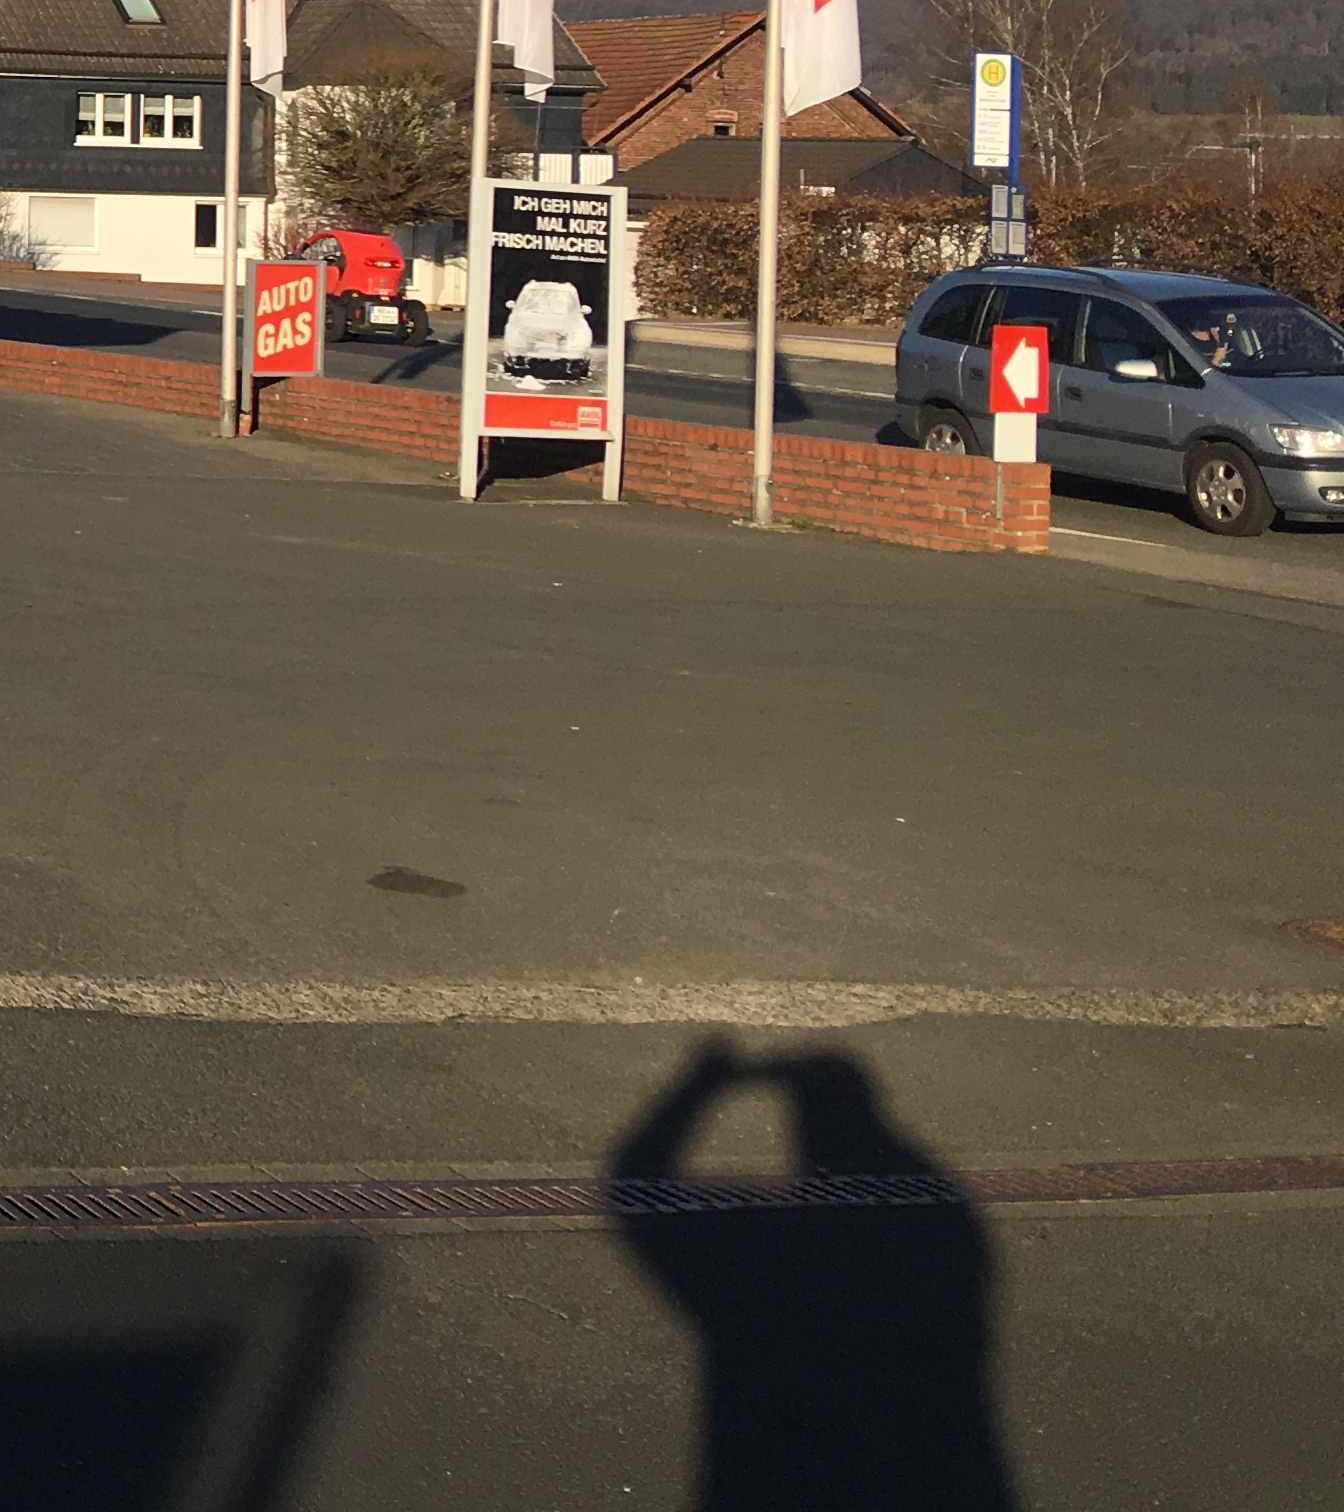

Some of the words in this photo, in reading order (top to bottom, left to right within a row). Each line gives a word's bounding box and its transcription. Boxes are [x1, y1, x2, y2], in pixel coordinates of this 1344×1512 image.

[513, 195, 539, 211] ICH
[540, 197, 571, 214] GEH
[572, 199, 608, 216] MICH
[536, 216, 567, 232] MAL
[569, 218, 607, 235] KURZ
[491, 231, 543, 249] FRISCH
[544, 235, 608, 254] MACHEN.
[256, 276, 313, 316] AUTO
[256, 311, 313, 358] GAS
